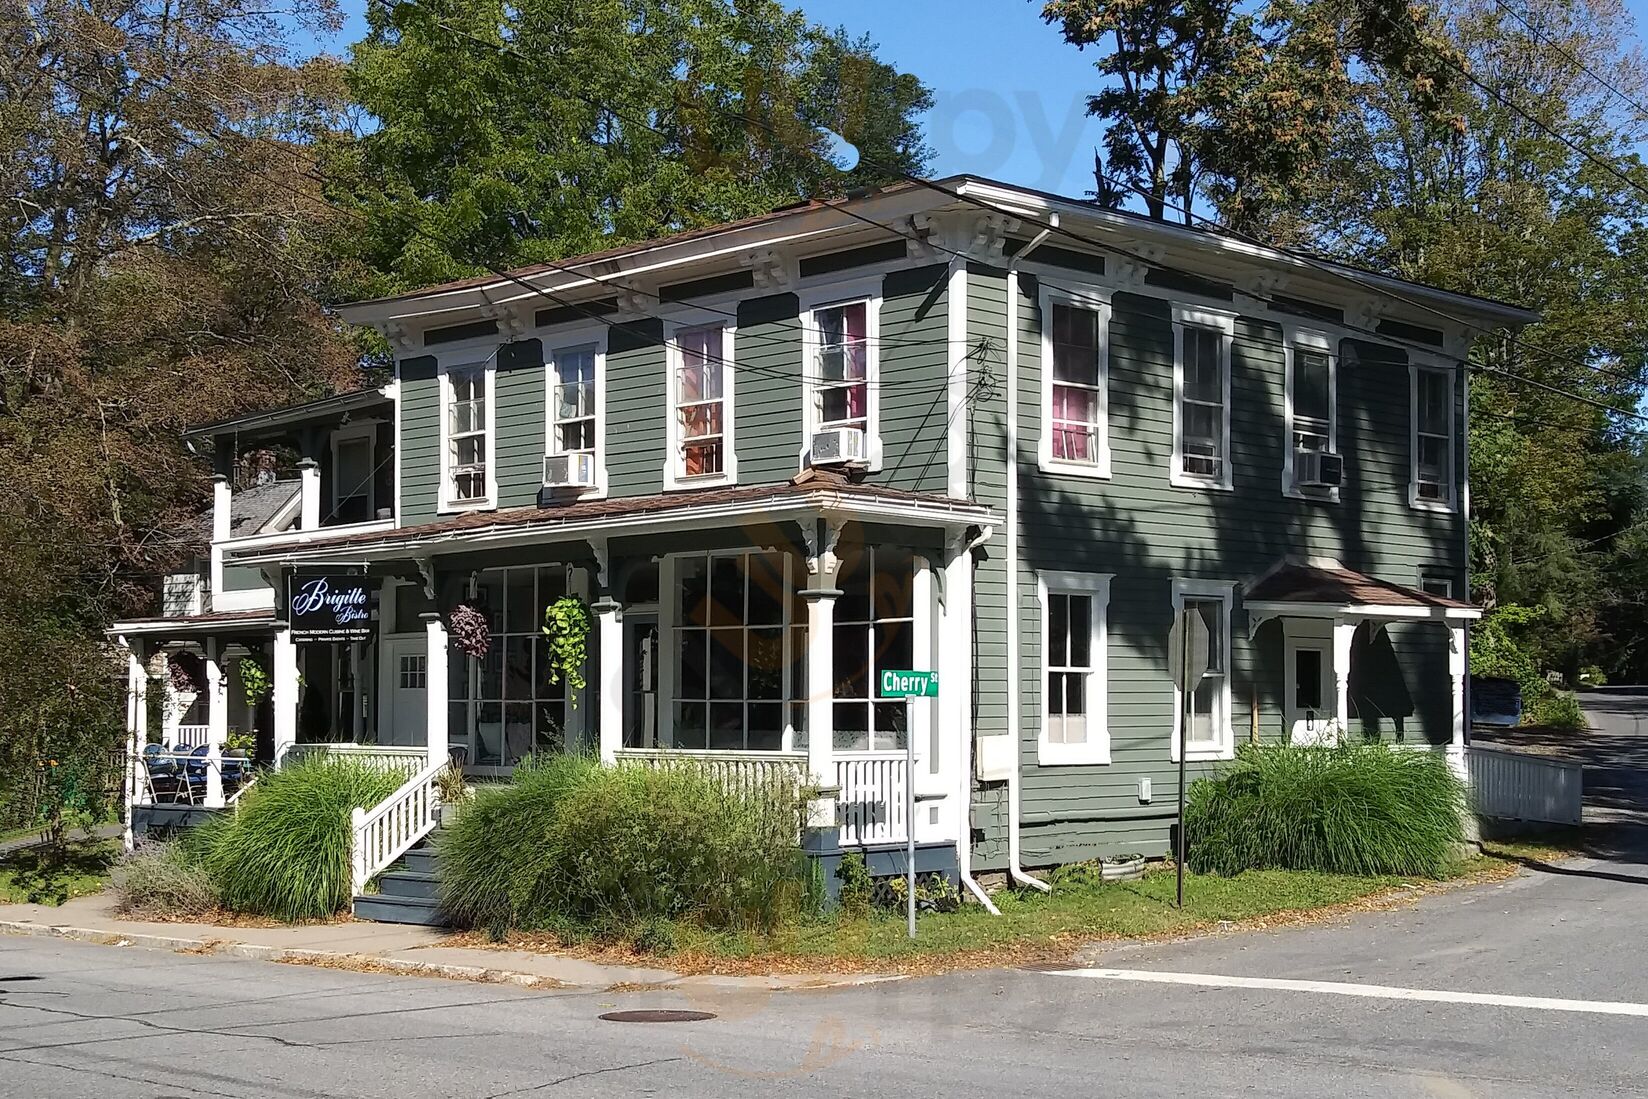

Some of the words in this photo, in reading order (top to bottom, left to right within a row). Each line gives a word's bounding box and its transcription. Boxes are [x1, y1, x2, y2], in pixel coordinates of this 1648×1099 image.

[292, 577, 366, 616] Brigitte
[335, 605, 369, 625] Bistro
[883, 671, 928, 696] Cherry
[930, 672, 938, 683] St
